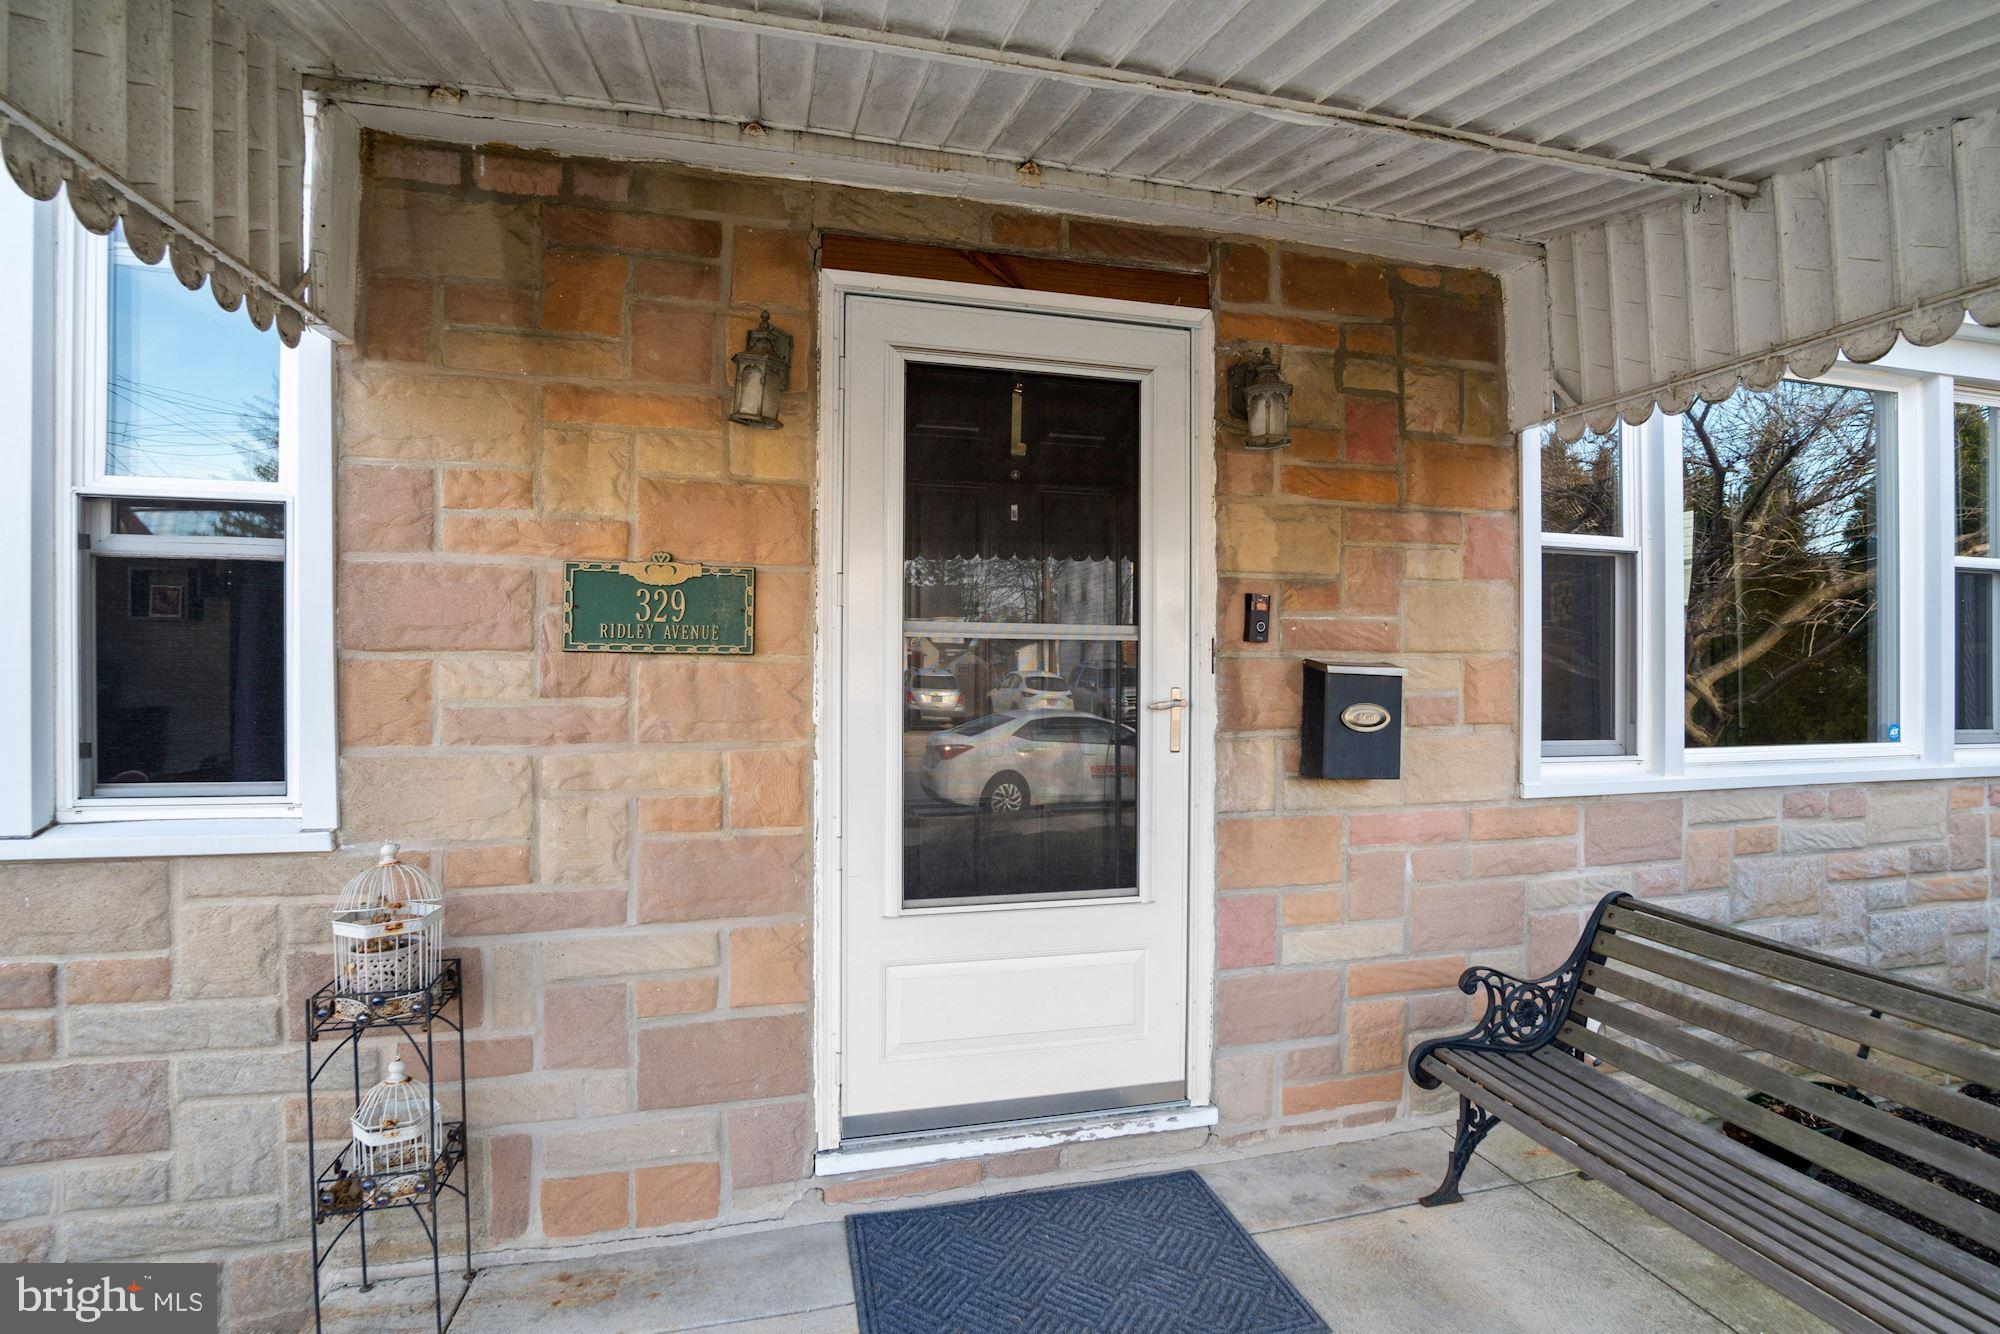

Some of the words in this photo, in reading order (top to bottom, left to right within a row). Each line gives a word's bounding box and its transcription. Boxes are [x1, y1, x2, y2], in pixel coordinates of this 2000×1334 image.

[635, 588, 686, 622] 329
[600, 623, 654, 639] RIDLEY
[663, 624, 719, 640] AVENUE
